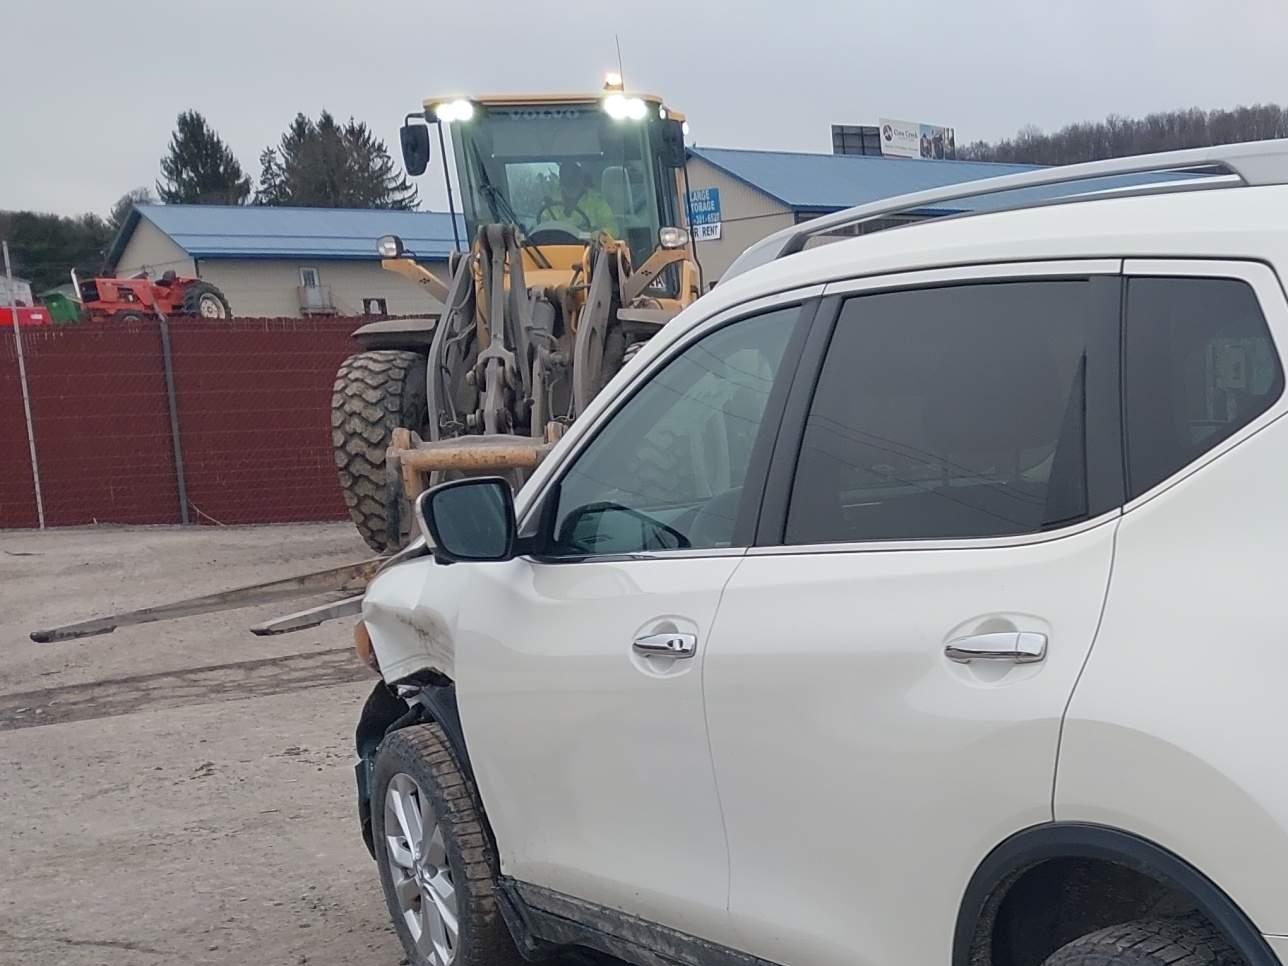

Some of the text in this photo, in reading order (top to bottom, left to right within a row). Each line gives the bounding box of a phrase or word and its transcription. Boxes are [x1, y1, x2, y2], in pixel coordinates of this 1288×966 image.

[690, 190, 710, 202] LARGE
[687, 200, 716, 213] TORAGE
[702, 225, 719, 237] RENT
